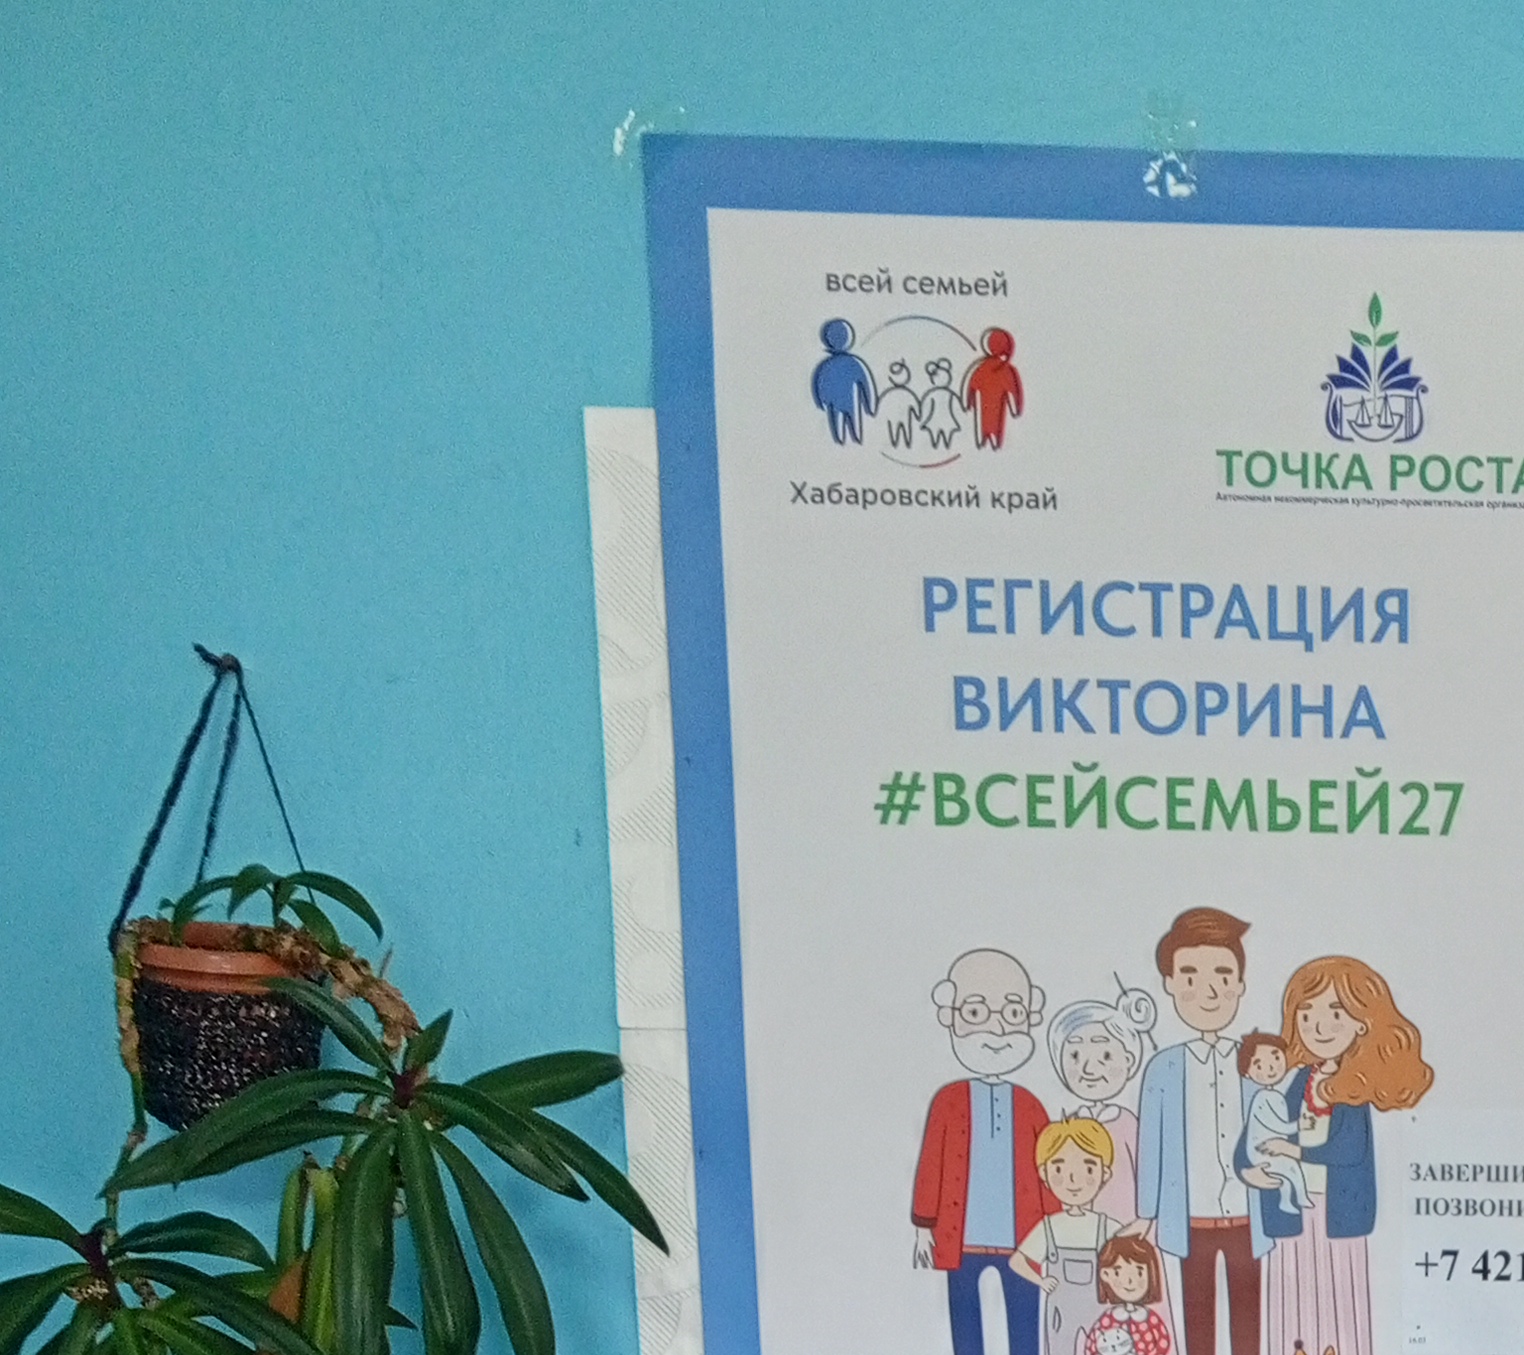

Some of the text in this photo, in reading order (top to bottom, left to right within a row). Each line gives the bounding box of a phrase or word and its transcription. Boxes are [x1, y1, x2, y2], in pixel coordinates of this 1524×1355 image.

[825, 267, 1008, 298] всей семьей
[1215, 448, 1373, 491] ТОЧКА
[790, 480, 1058, 515] Хабаровский край
[922, 576, 1410, 653] РЕГИСТРАЦИЯ
[952, 675, 1387, 741] ВИКТОРИНА
[873, 761, 1465, 838] #ВСЕЙСЕМЬЕЙ27
[1415, 1249, 1460, 1282] +7
